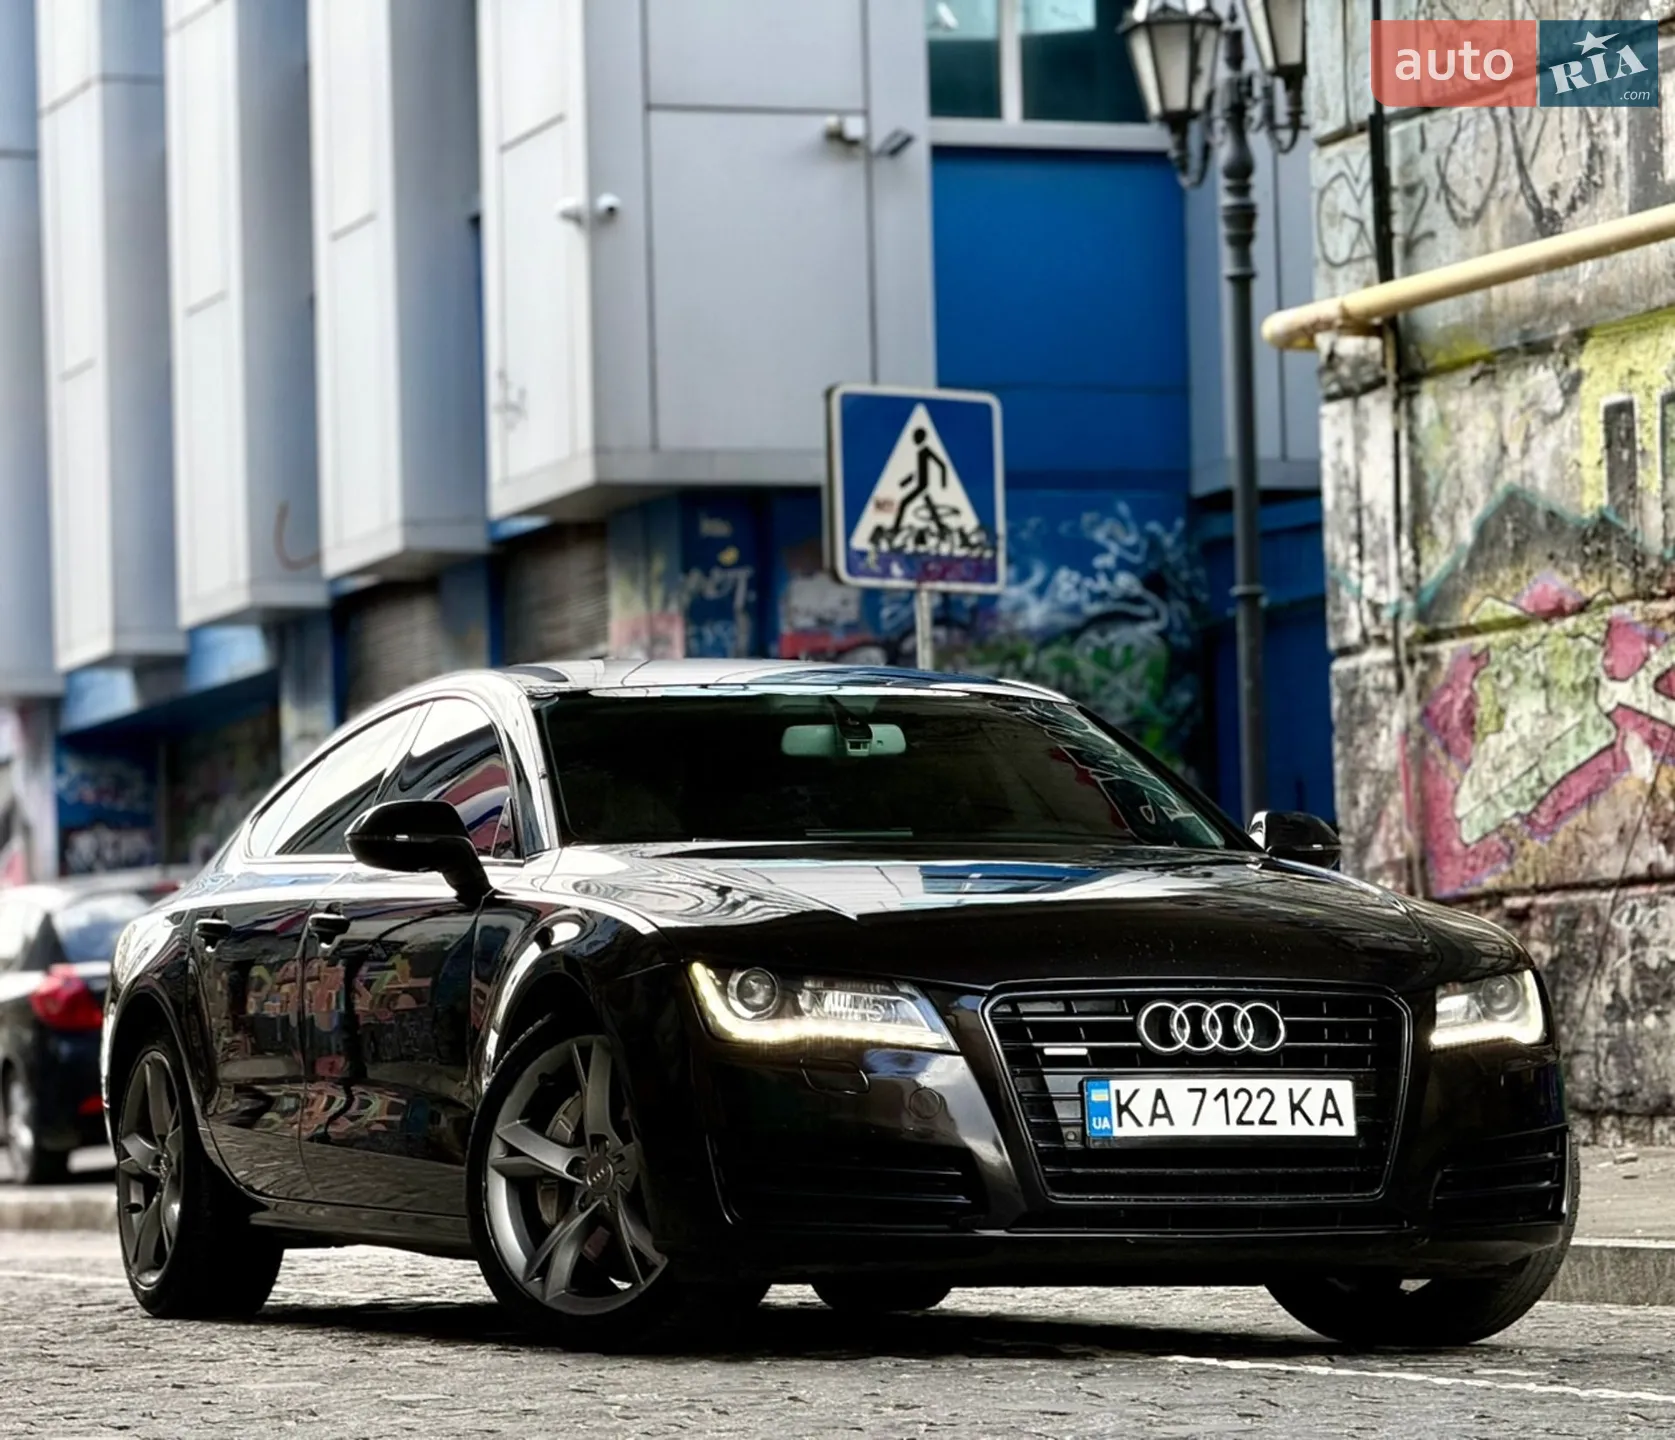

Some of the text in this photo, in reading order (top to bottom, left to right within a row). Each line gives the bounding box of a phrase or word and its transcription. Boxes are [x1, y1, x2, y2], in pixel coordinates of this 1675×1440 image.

[1114, 1087, 1344, 1128] KA 7122 KA
[1092, 1116, 1112, 1130] UA
